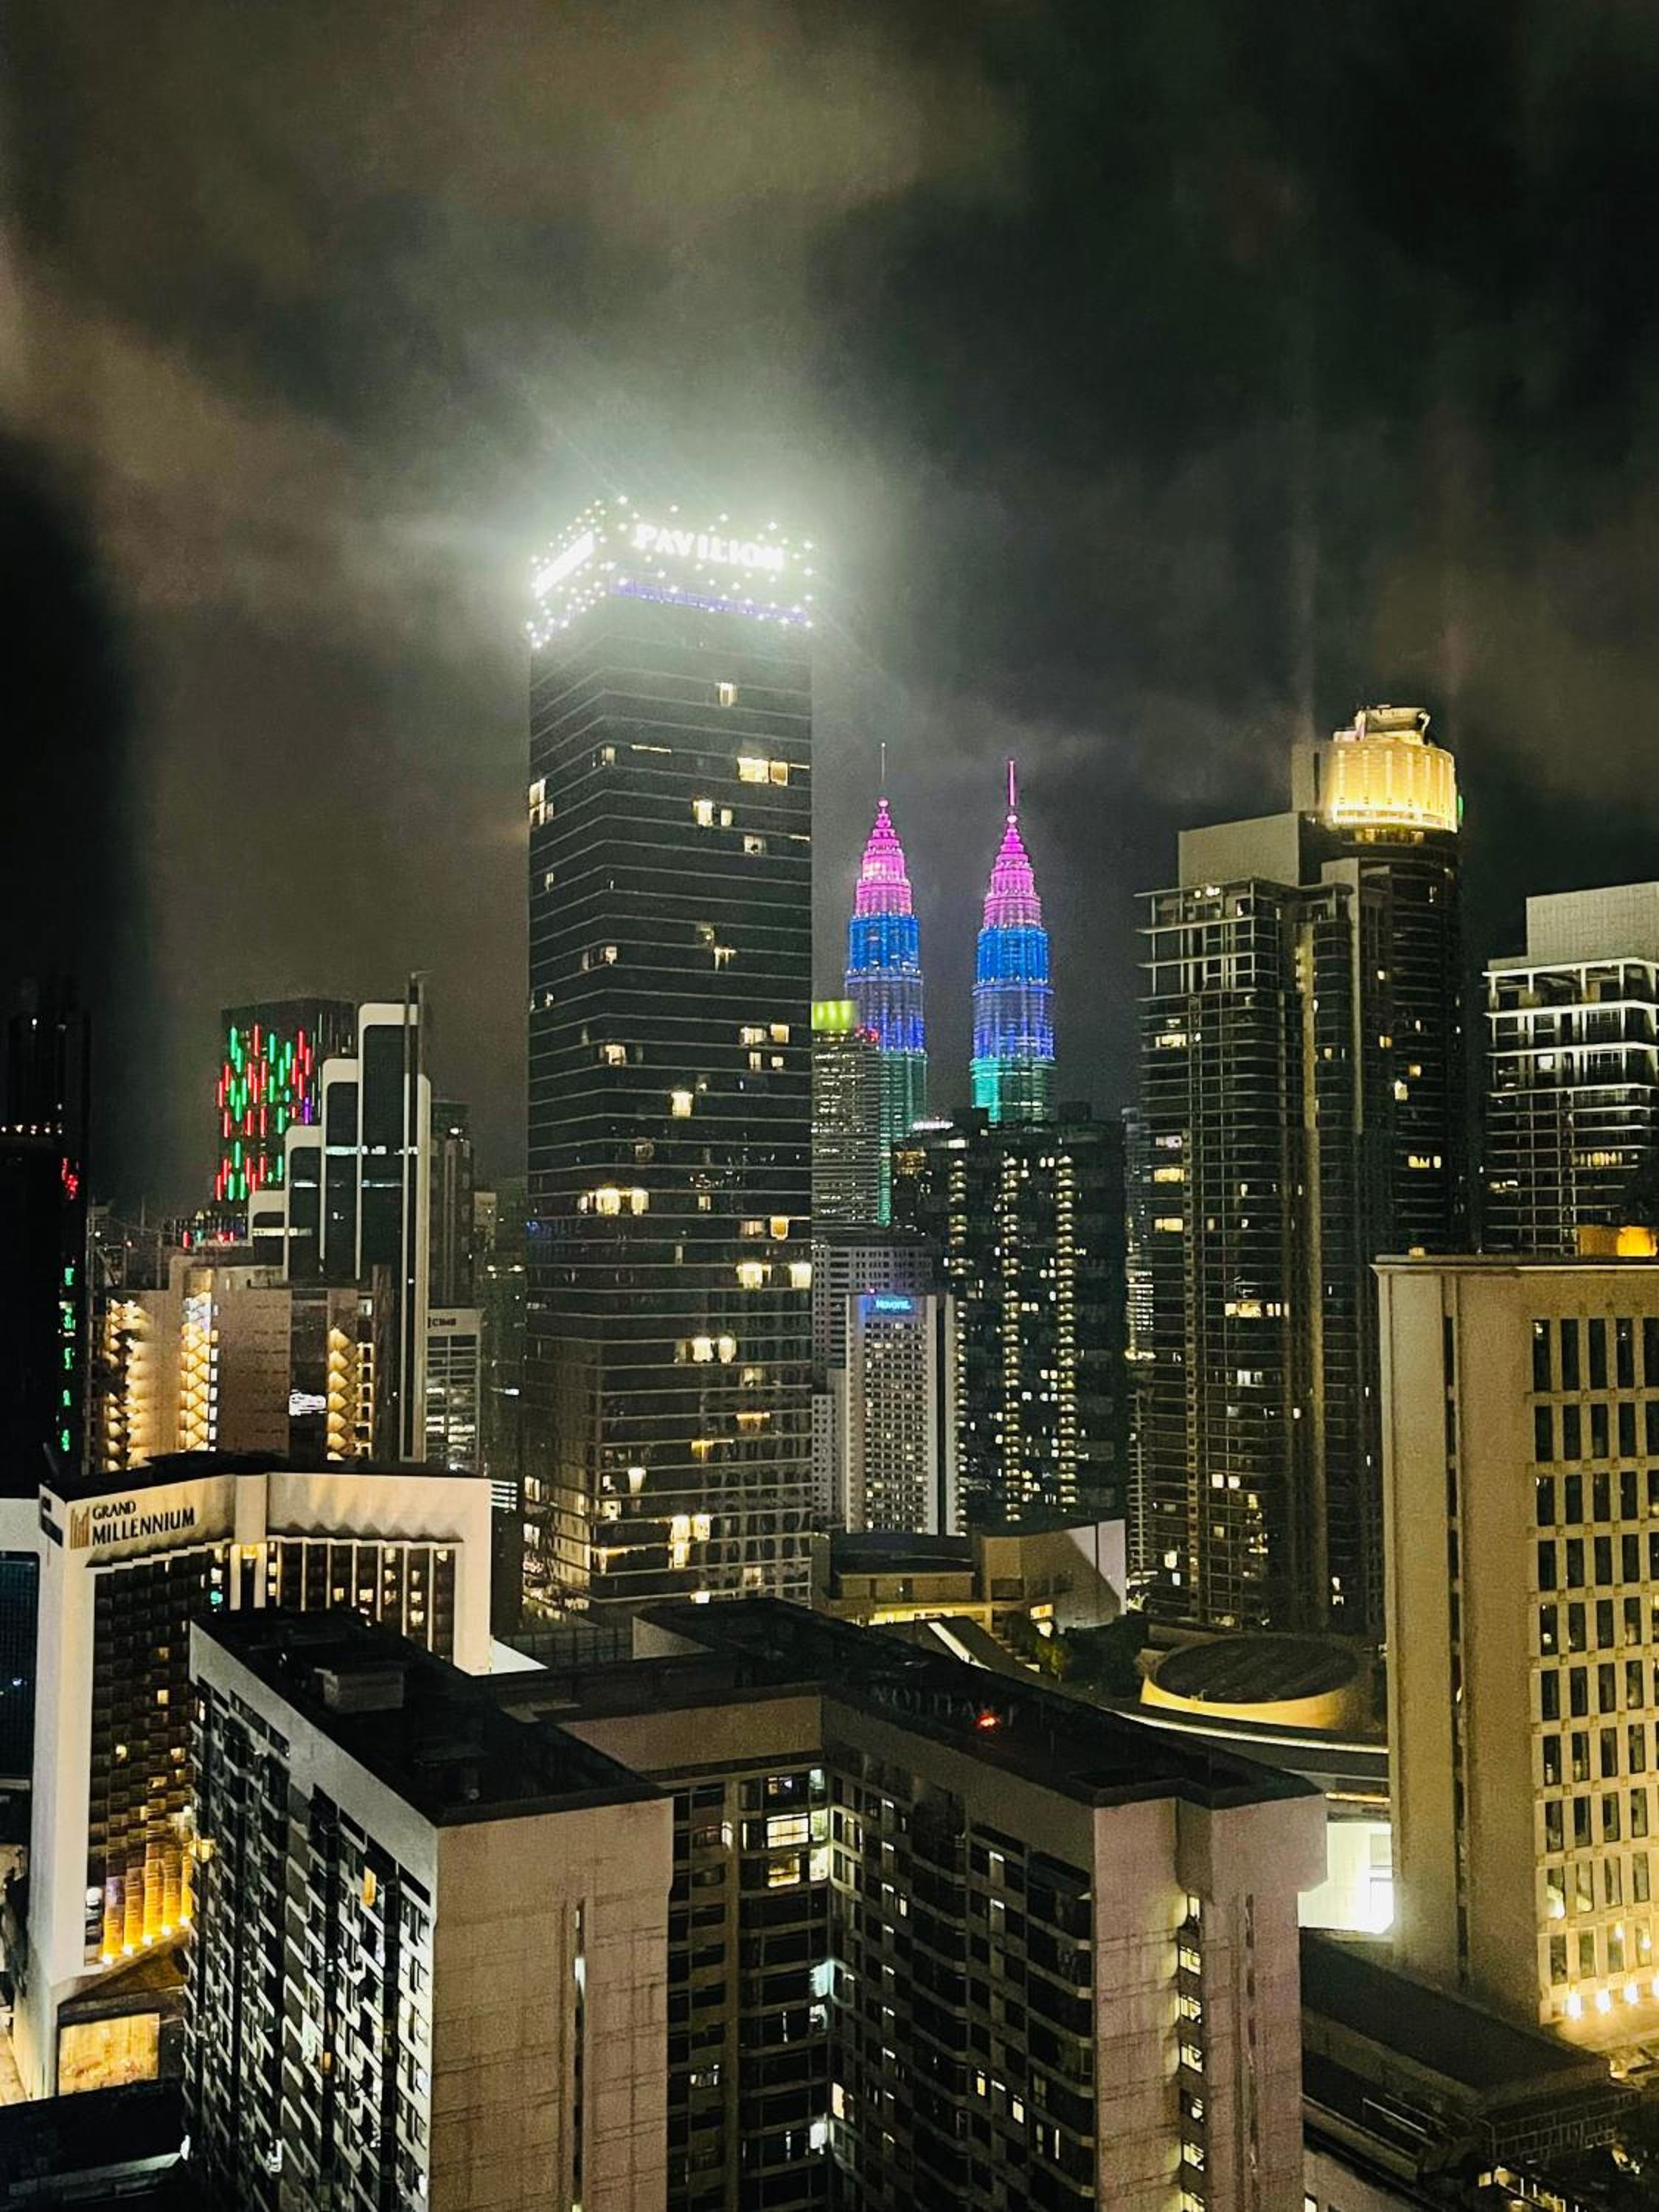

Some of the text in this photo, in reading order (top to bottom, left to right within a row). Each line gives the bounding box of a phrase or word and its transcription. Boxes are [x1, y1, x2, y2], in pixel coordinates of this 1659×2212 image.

[636, 524, 783, 569] PAVILION
[93, 1500, 136, 1520] GRAND
[93, 1508, 195, 1545] MILLENNIUM
